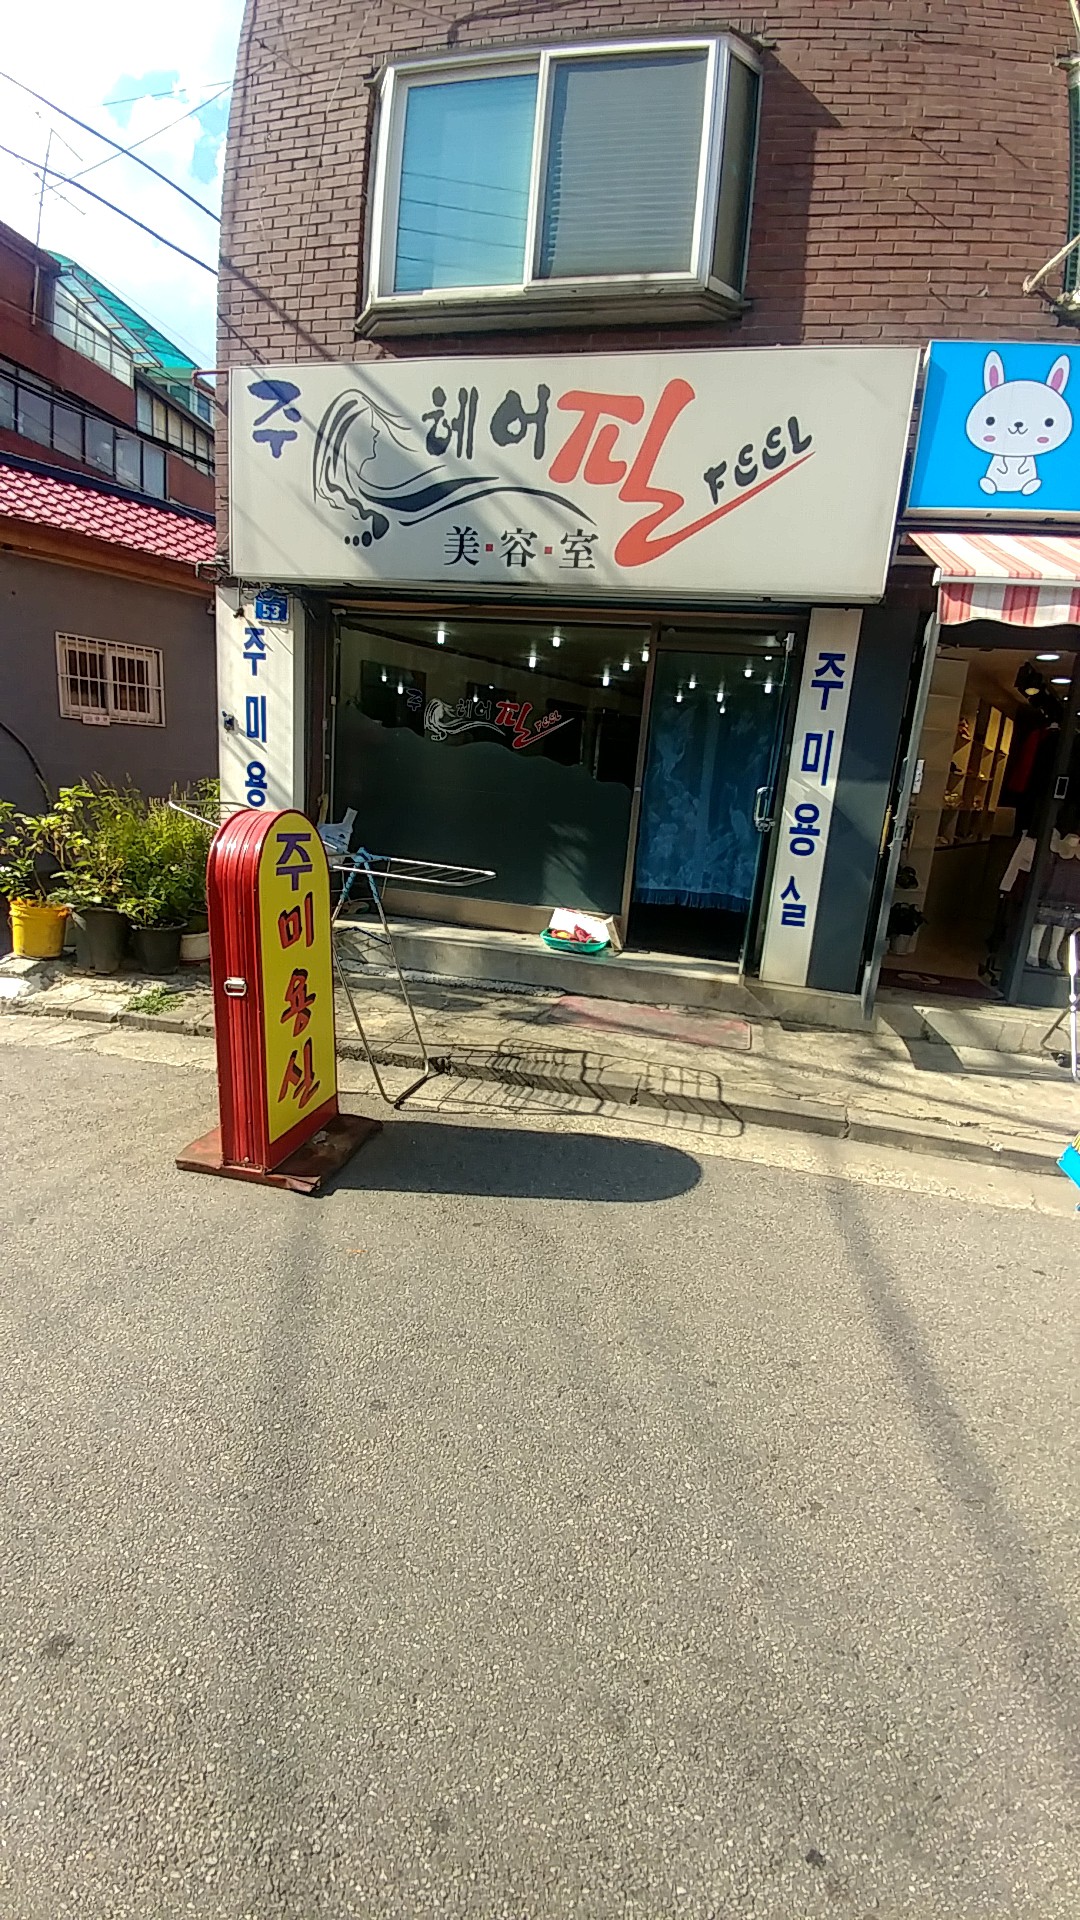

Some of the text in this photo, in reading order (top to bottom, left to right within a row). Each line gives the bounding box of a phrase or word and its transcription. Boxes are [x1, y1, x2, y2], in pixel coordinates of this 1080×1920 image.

[246, 379, 301, 459] 주
[703, 415, 813, 505] FEEL
[262, 603, 281, 619] 53
